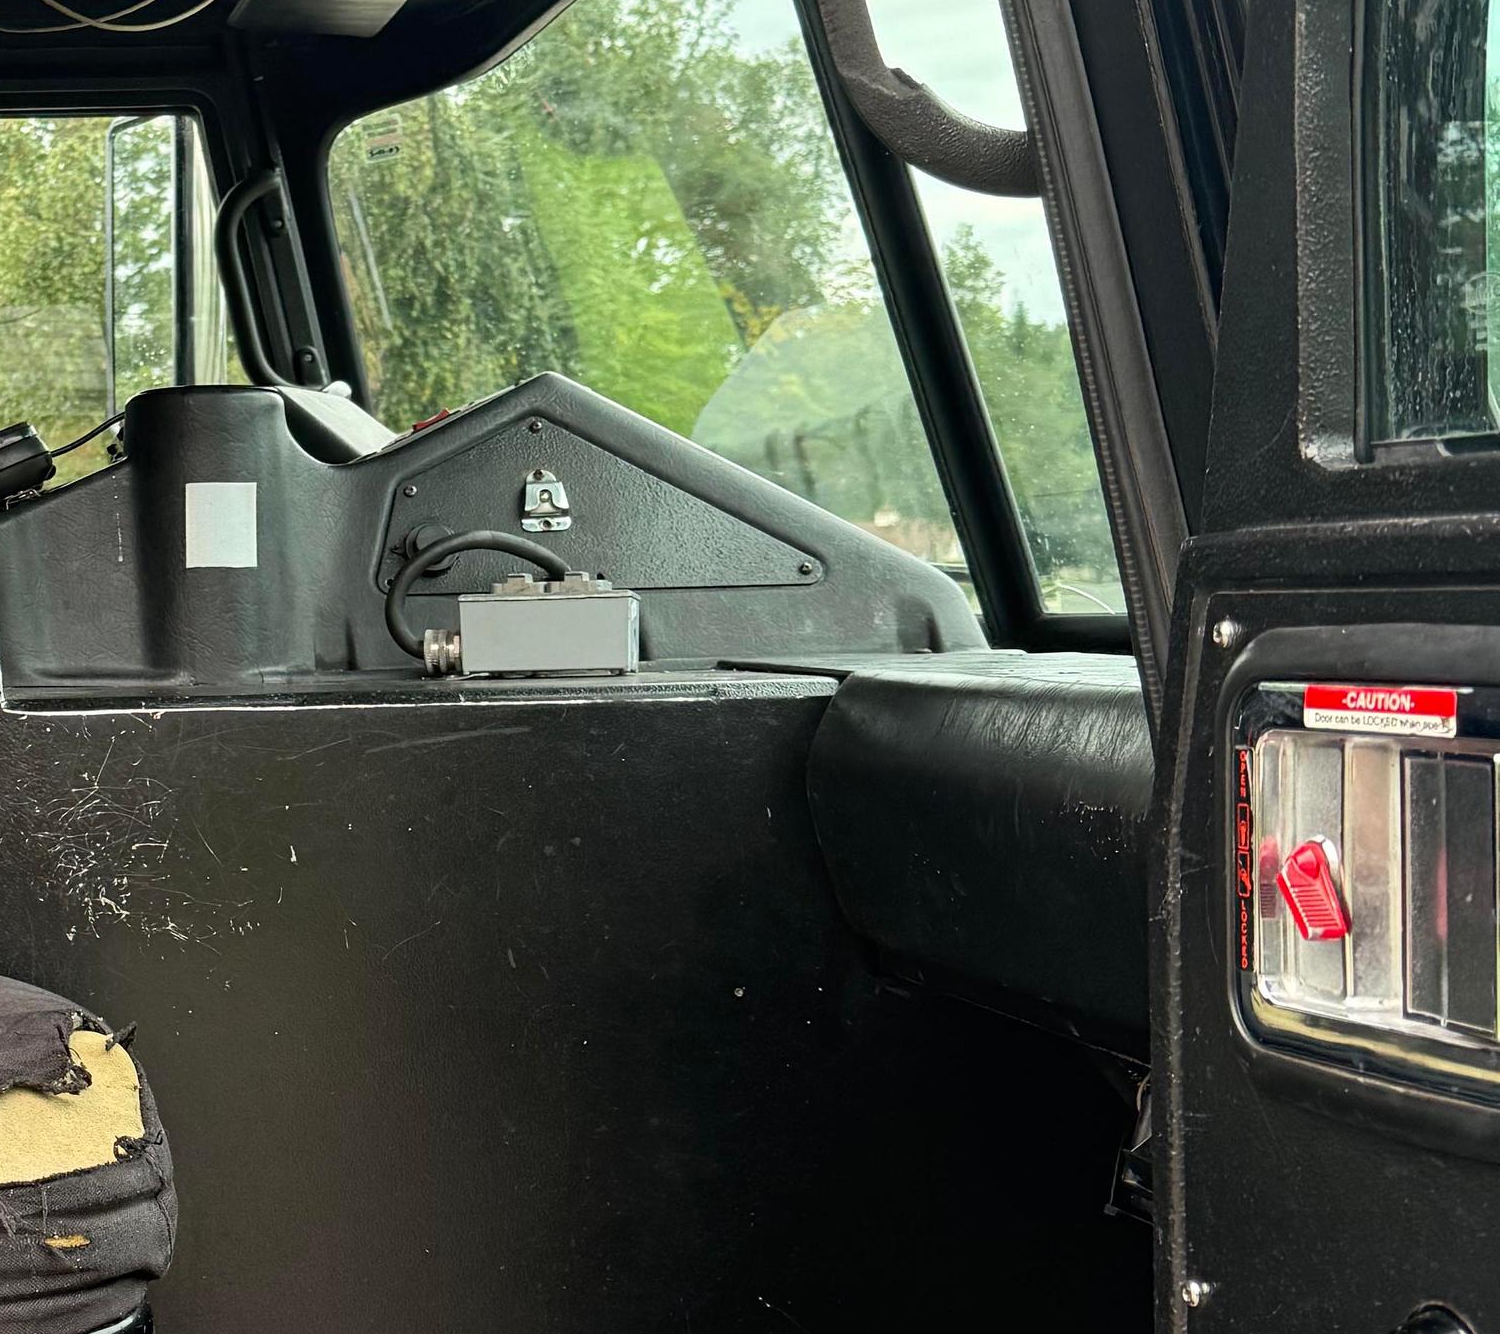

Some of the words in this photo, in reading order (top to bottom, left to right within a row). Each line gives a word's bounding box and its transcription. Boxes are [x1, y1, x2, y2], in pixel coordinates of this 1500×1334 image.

[1315, 712, 1332, 723] Door
[1334, 714, 1349, 724] can
[1350, 714, 1361, 725] be
[1240, 900, 1249, 970] LOCKED
